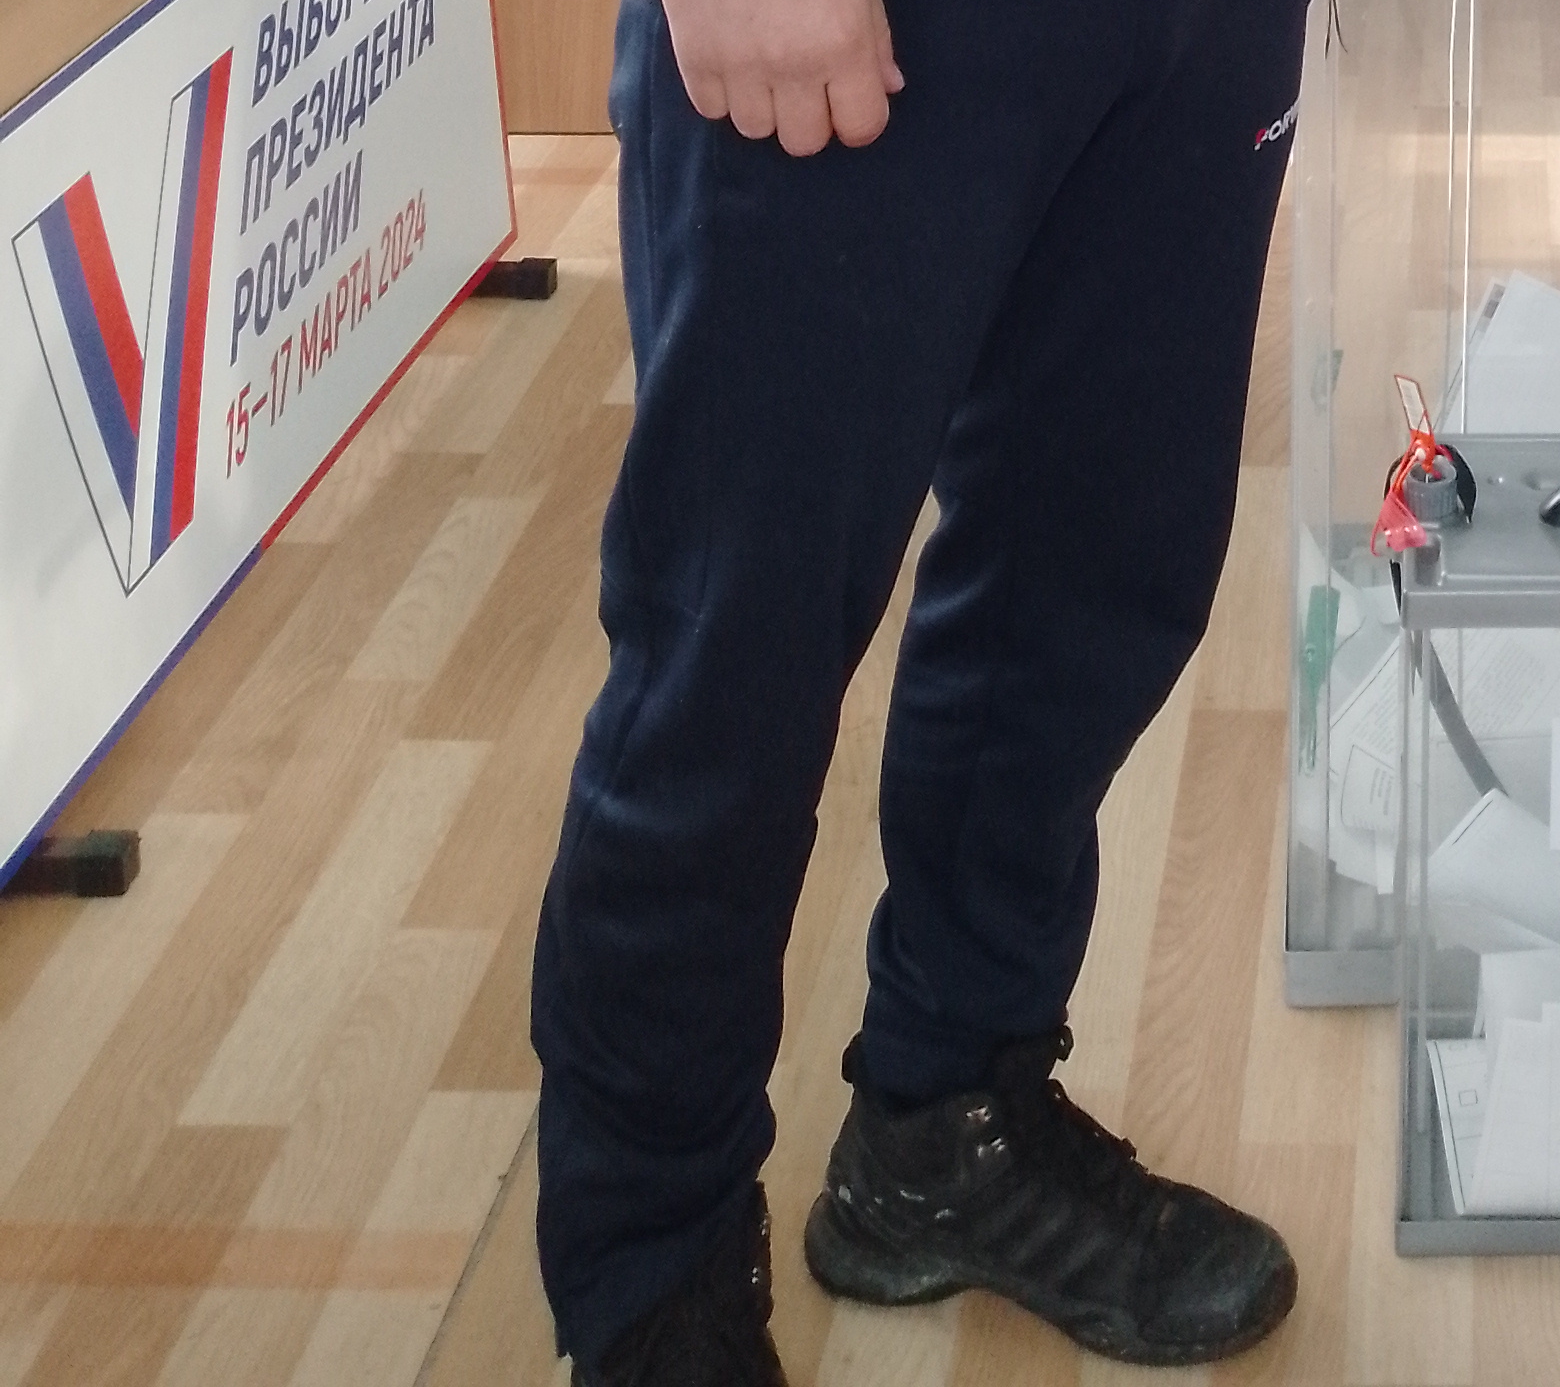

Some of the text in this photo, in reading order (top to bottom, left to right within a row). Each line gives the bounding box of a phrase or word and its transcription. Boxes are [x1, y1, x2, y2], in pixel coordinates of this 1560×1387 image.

[229, 148, 363, 367] РОССИИ
[297, 247, 372, 395] МАРТА
[377, 188, 427, 301] 2024
